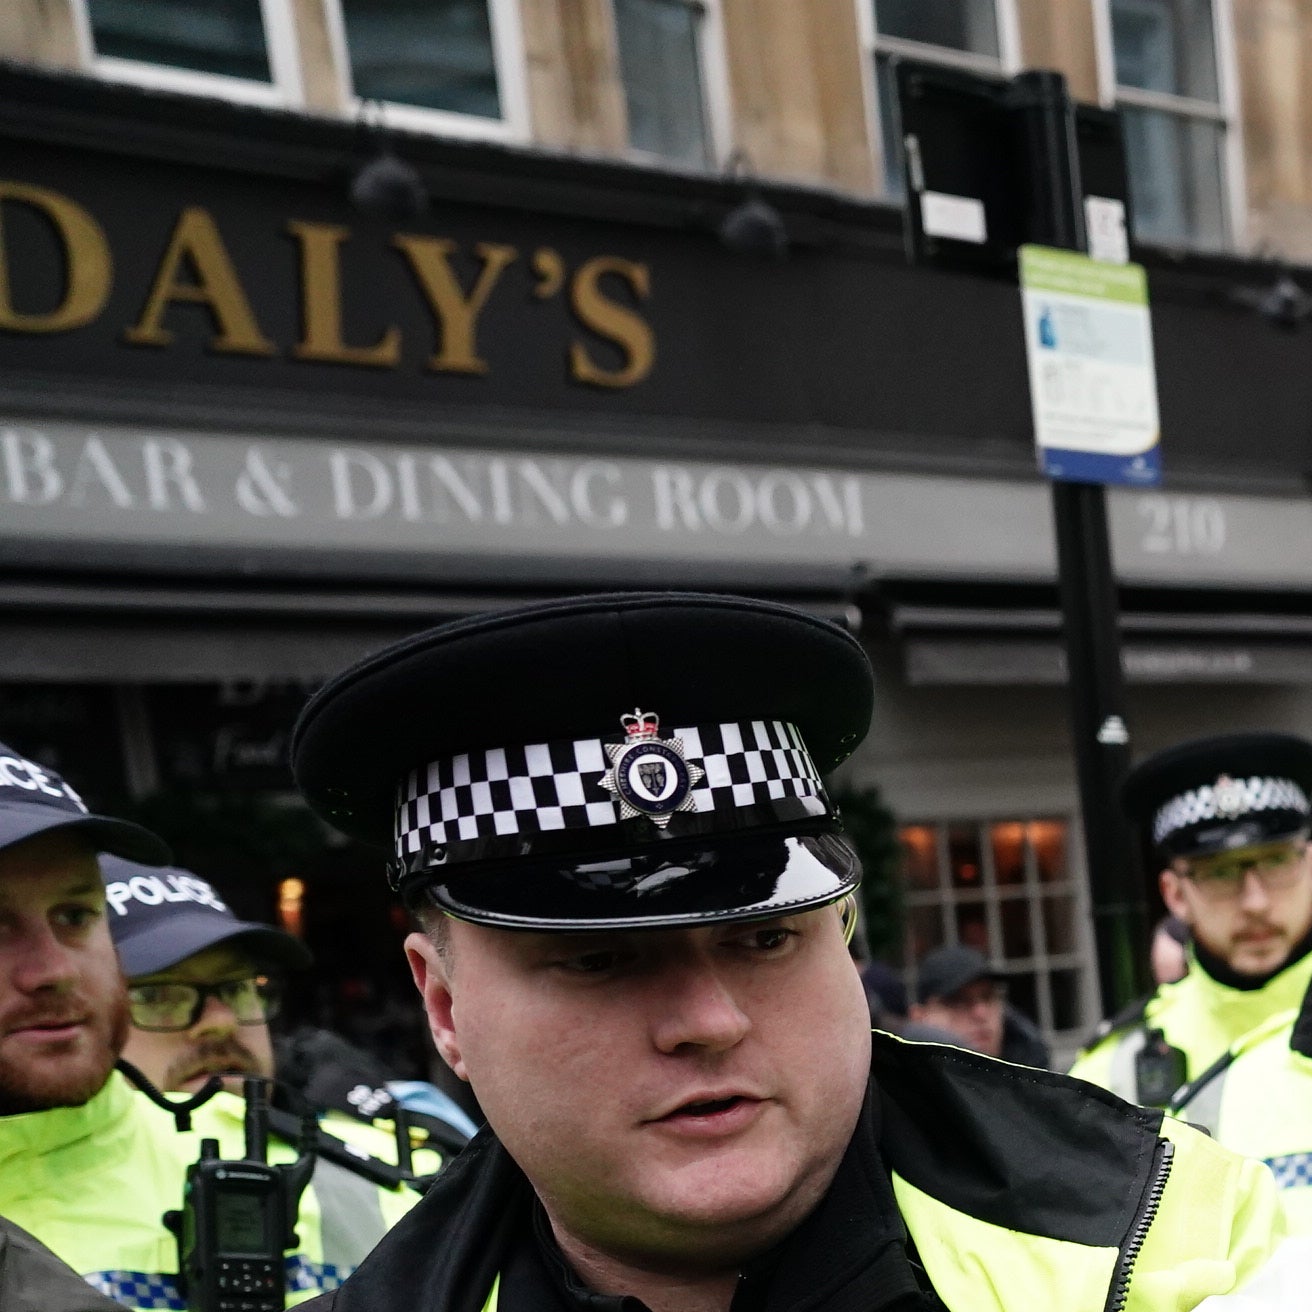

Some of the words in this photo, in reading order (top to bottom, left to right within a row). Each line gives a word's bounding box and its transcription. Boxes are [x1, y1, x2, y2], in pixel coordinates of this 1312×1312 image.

[0, 181, 657, 388] DALY'S
[4, 430, 206, 514] BAR
[235, 444, 299, 518] &
[328, 449, 627, 527] DINING
[651, 465, 865, 538] ROOM
[1137, 499, 1226, 554] 210
